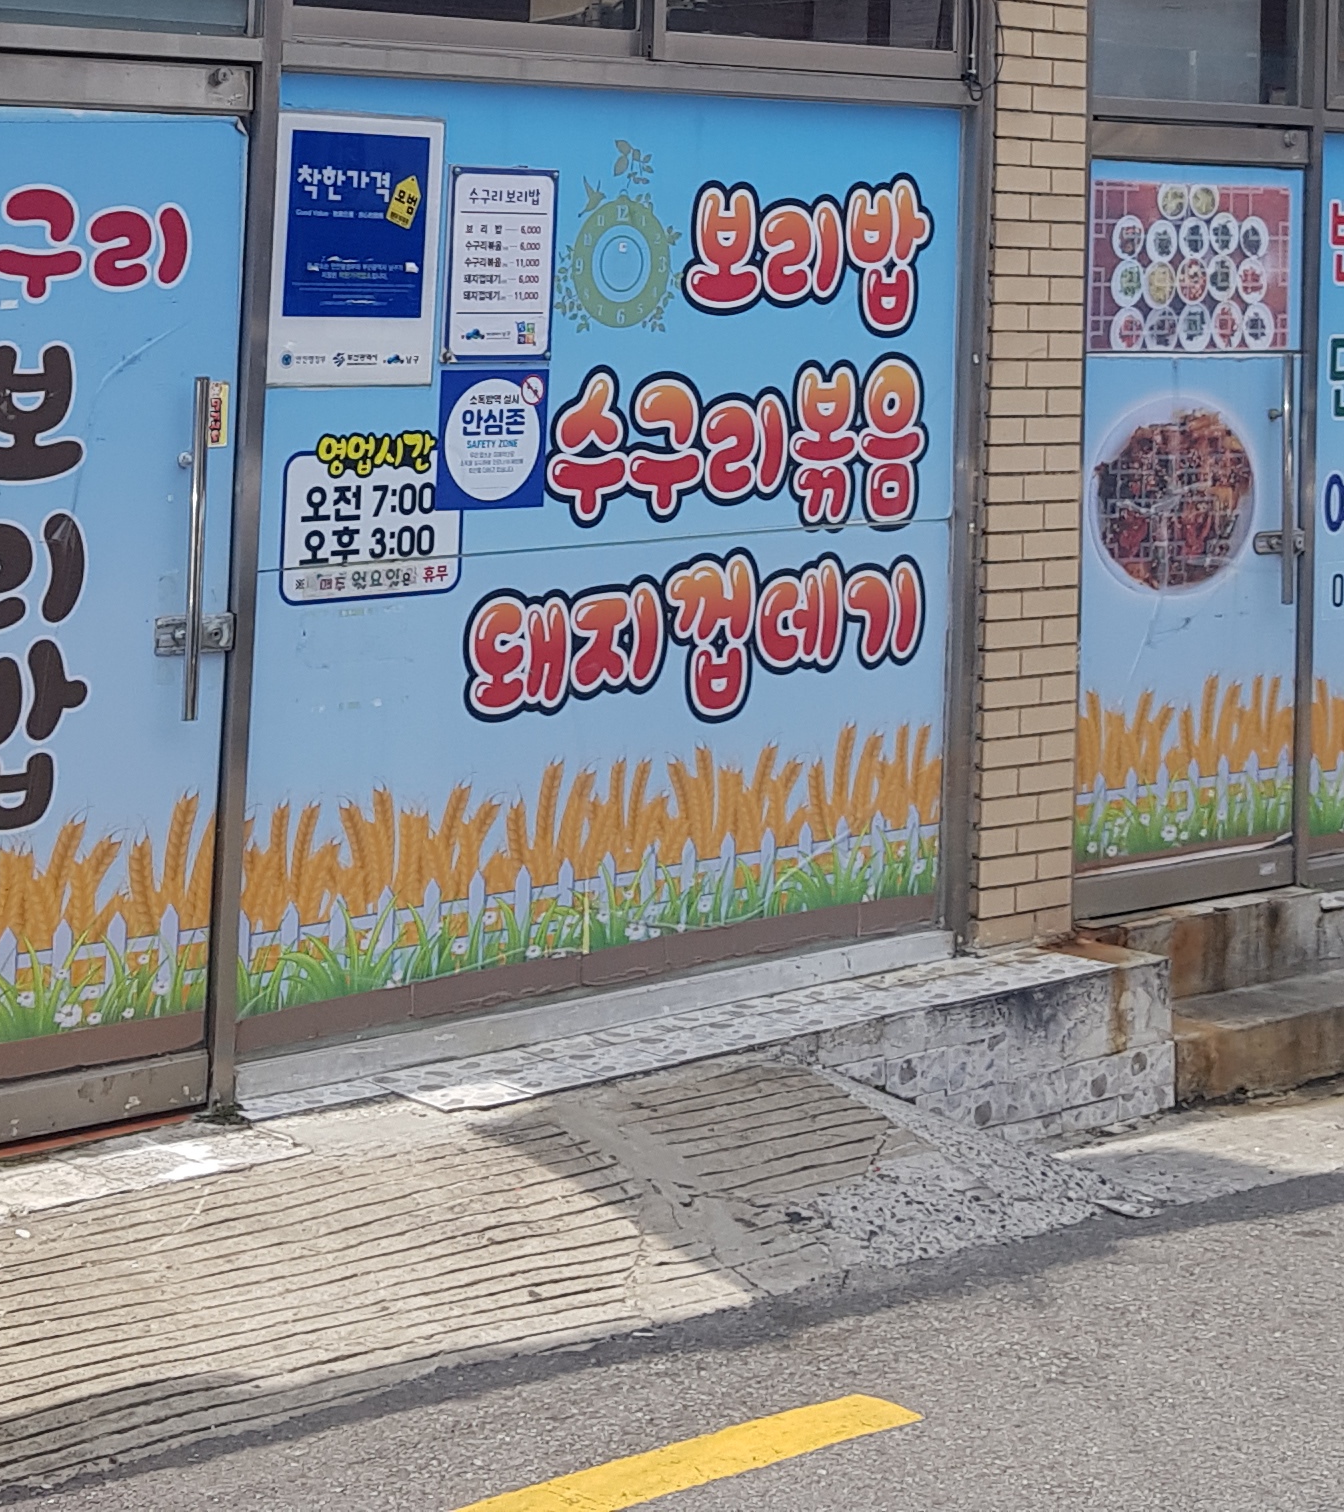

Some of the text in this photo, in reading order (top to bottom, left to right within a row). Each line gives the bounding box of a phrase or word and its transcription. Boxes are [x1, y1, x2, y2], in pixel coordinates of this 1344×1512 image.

[296, 164, 418, 216] 착한가격 모범
[469, 188, 541, 206] 수구리 보리밥
[515, 259, 540, 268] 11,000
[692, 178, 934, 335] 보리밥
[514, 292, 539, 301] 11,000
[469, 394, 519, 405] 소독방역 실시
[462, 409, 525, 436] 안심존
[549, 355, 930, 522] 수구리볶음
[316, 432, 436, 478] 영업시간
[467, 439, 518, 449] SAFETY ZONE
[301, 482, 436, 522] 오전 7:00
[299, 524, 435, 567] 오후 3:00
[423, 565, 449, 583] 휴무
[468, 552, 926, 716] 돼지껍데기
